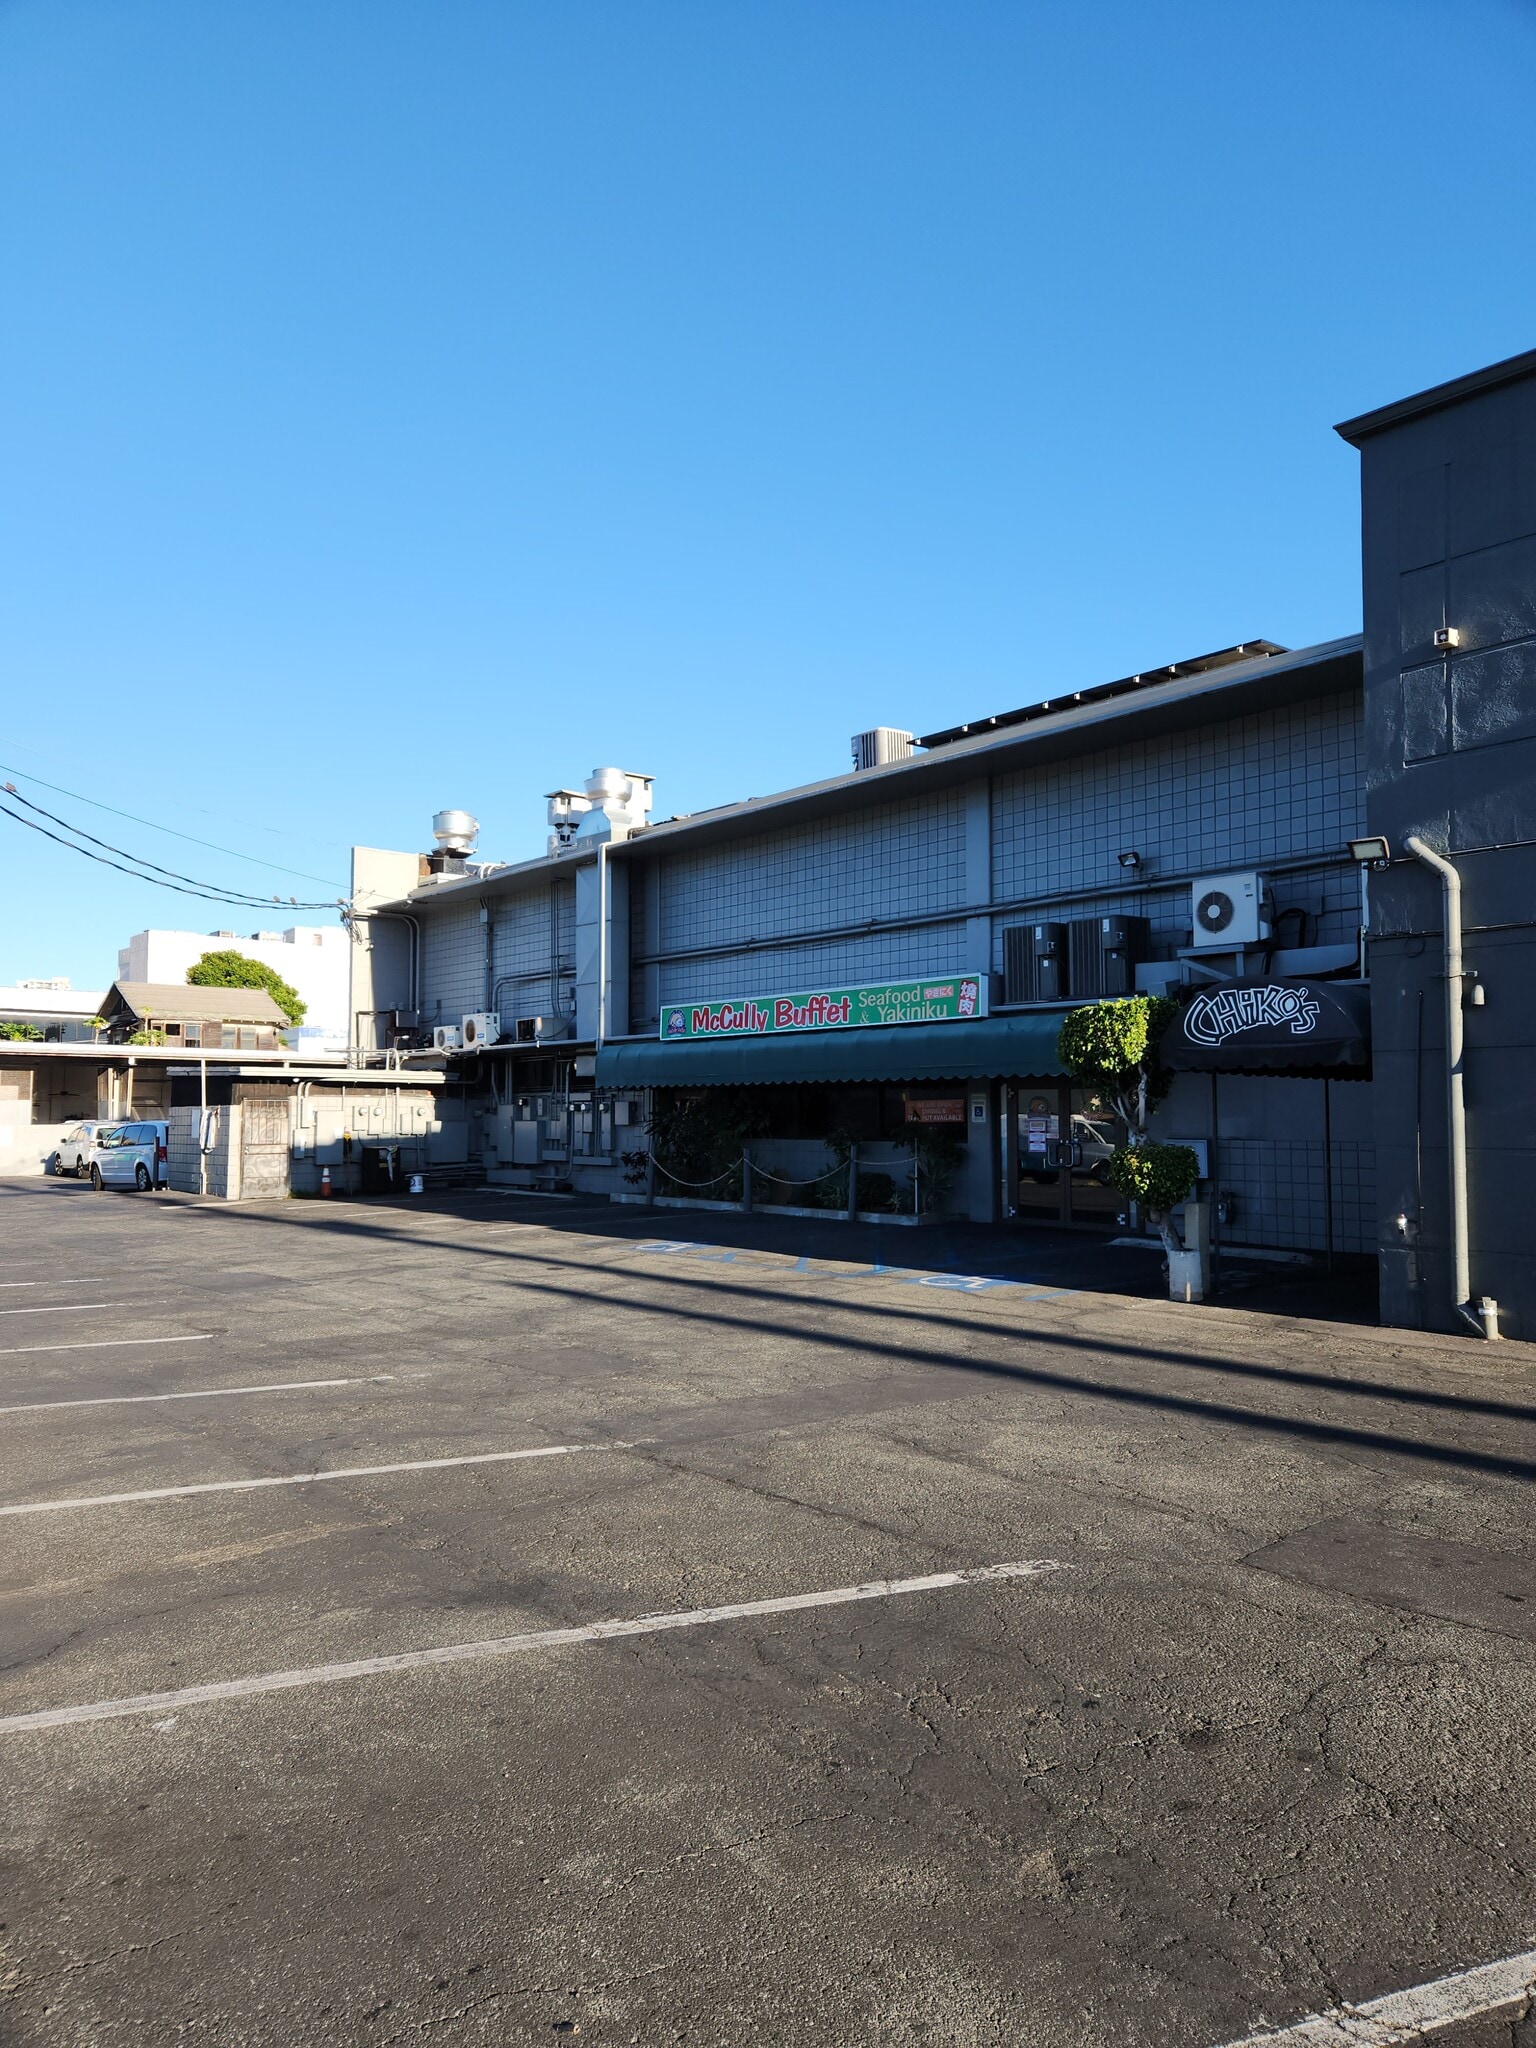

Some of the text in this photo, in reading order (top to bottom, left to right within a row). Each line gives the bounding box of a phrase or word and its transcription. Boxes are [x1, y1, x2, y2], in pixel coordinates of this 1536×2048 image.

[858, 985, 921, 1008] Seafood
[924, 986, 953, 999] やきにく
[691, 995, 852, 1033] McCully Buffet
[859, 1000, 947, 1025] & Yakiniku
